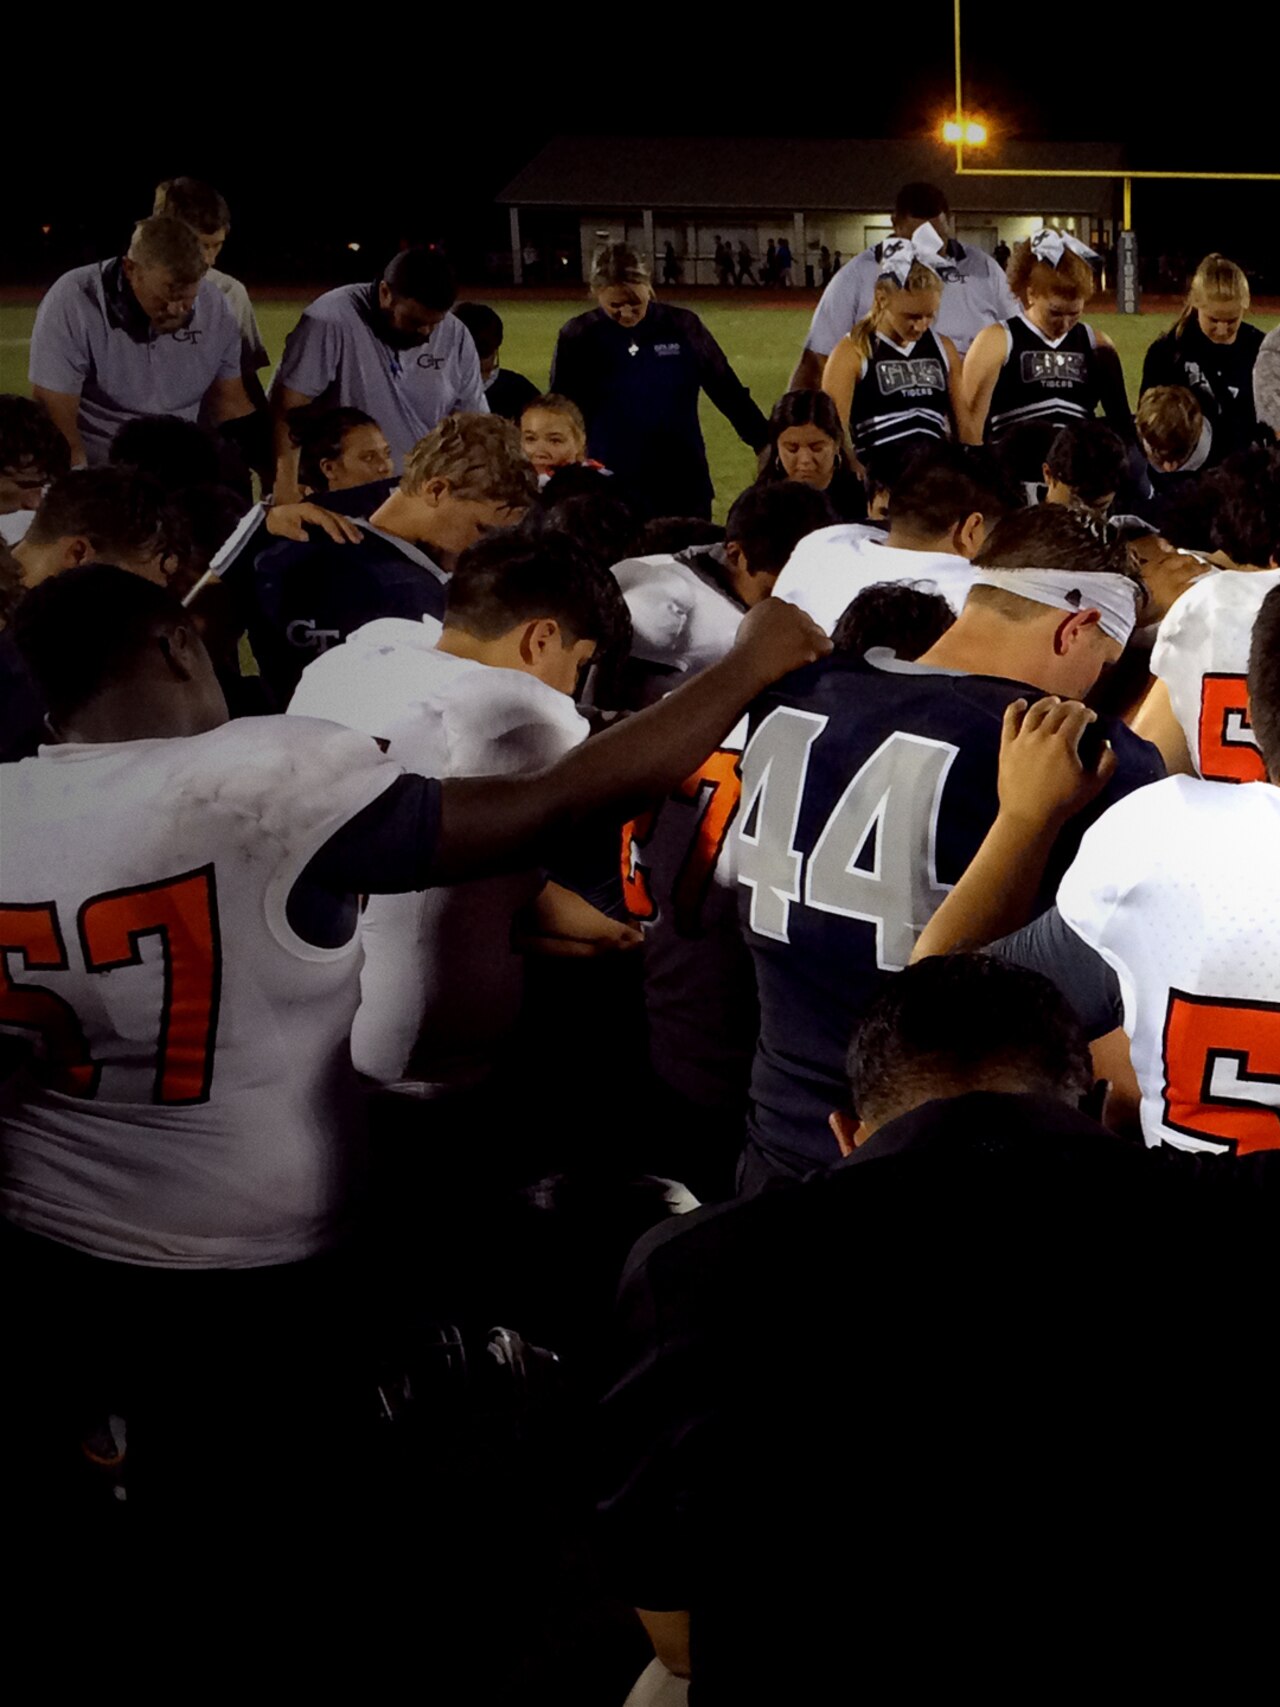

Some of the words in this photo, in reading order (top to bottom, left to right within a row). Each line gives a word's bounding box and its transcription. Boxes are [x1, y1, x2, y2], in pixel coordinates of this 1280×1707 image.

[417, 353, 445, 370] GT
[286, 618, 340, 654] GT
[738, 705, 959, 972] 44
